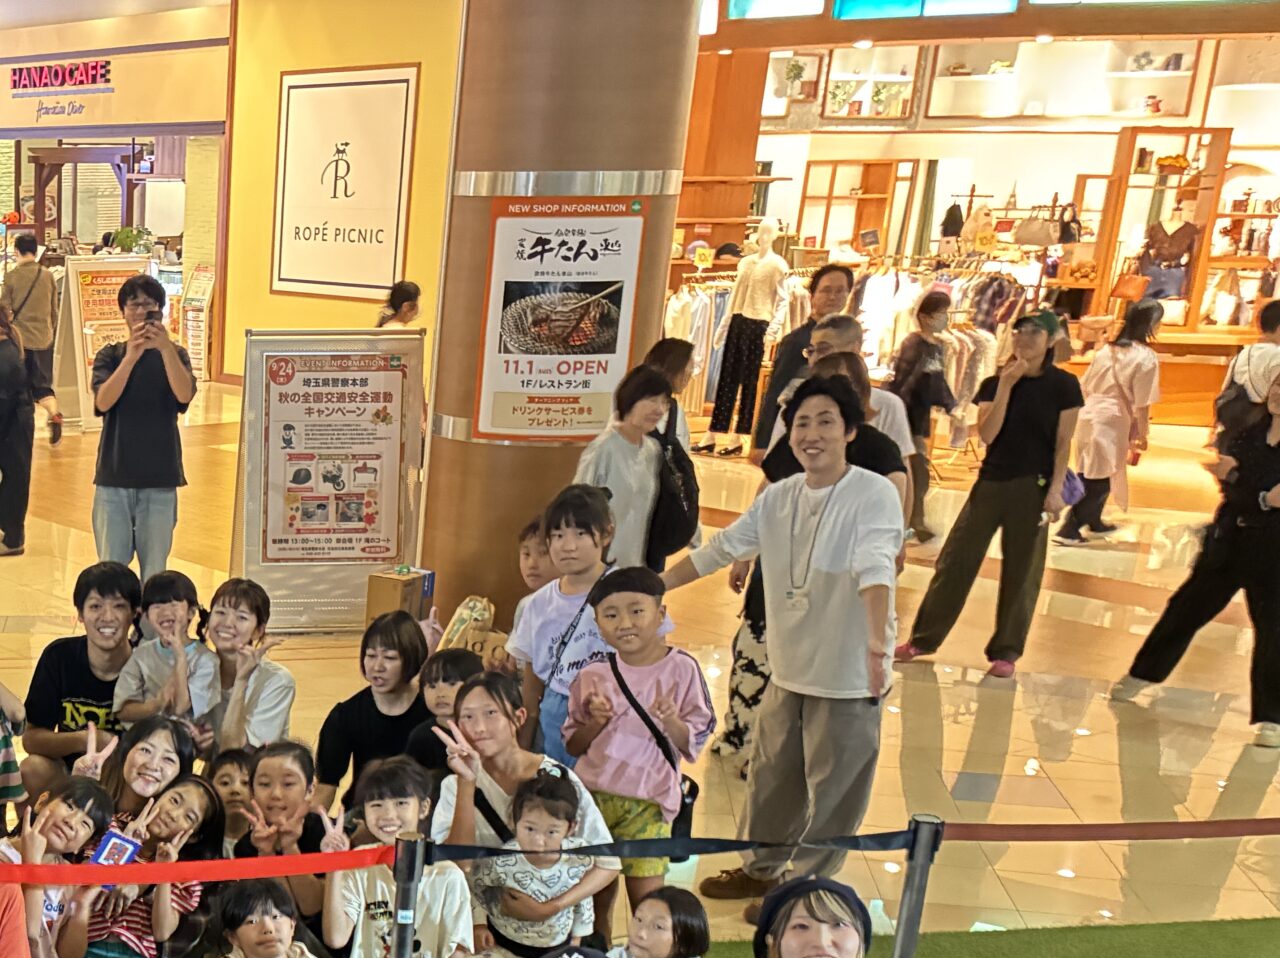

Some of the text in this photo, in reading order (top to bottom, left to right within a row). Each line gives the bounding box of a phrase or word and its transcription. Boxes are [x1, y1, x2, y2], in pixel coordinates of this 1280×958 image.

[10, 60, 111, 89] HANAO CAFE
[508, 203, 626, 213] NEW SHOP INFORMATION
[294, 221, 385, 244] ROPÉ PICNIC
[527, 236, 599, 265] 牛たん
[328, 358, 385, 367] INFORMATION
[503, 360, 534, 375] 11.1
[556, 360, 609, 376] OPEN
[278, 391, 393, 404] 秋の全国交通安全運動
[304, 406, 367, 418] キャンペーン
